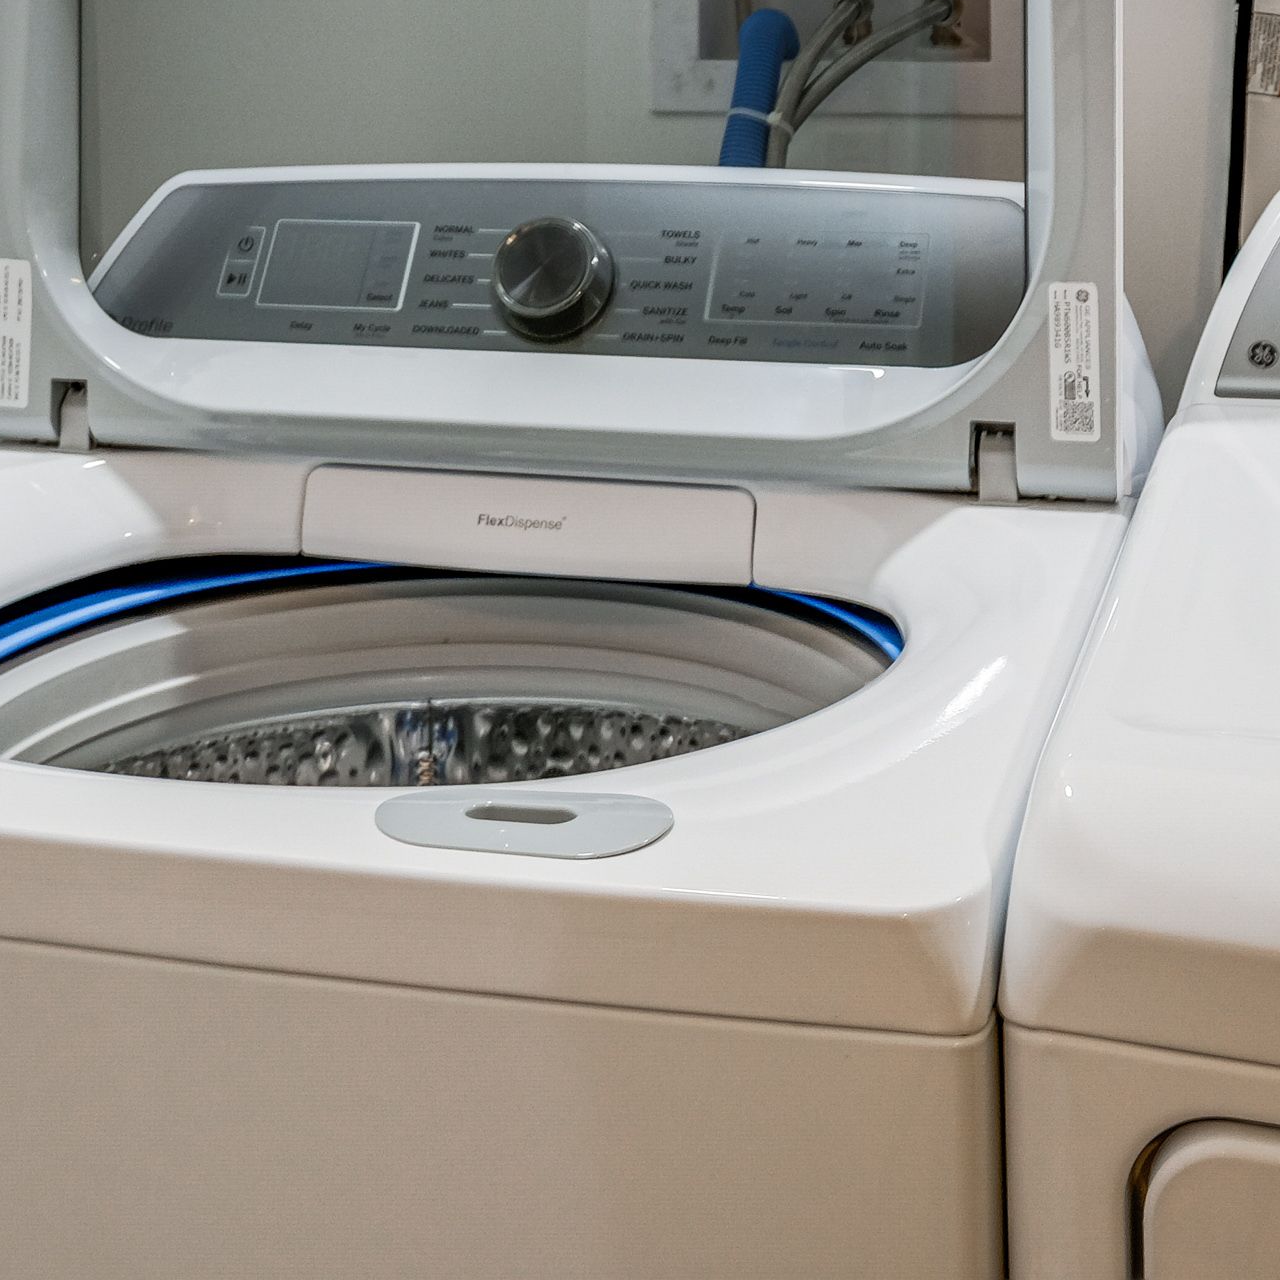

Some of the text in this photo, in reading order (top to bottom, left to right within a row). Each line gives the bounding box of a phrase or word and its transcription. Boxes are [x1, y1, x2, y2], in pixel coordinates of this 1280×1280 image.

[433, 225, 475, 234] NORMAL
[661, 229, 701, 240] TOWELS
[429, 249, 466, 259] WHITES
[664, 256, 698, 264] BULKY
[423, 274, 475, 285] DELICATES
[630, 280, 693, 290] QUICK WASH
[418, 300, 450, 309] JEANS
[642, 306, 689, 316] SANITIZE
[873, 309, 901, 318] Rinse
[411, 325, 480, 336] DOWNLOADED
[859, 341, 882, 350] Auto
[477, 513, 563, 531] FlexDispense
